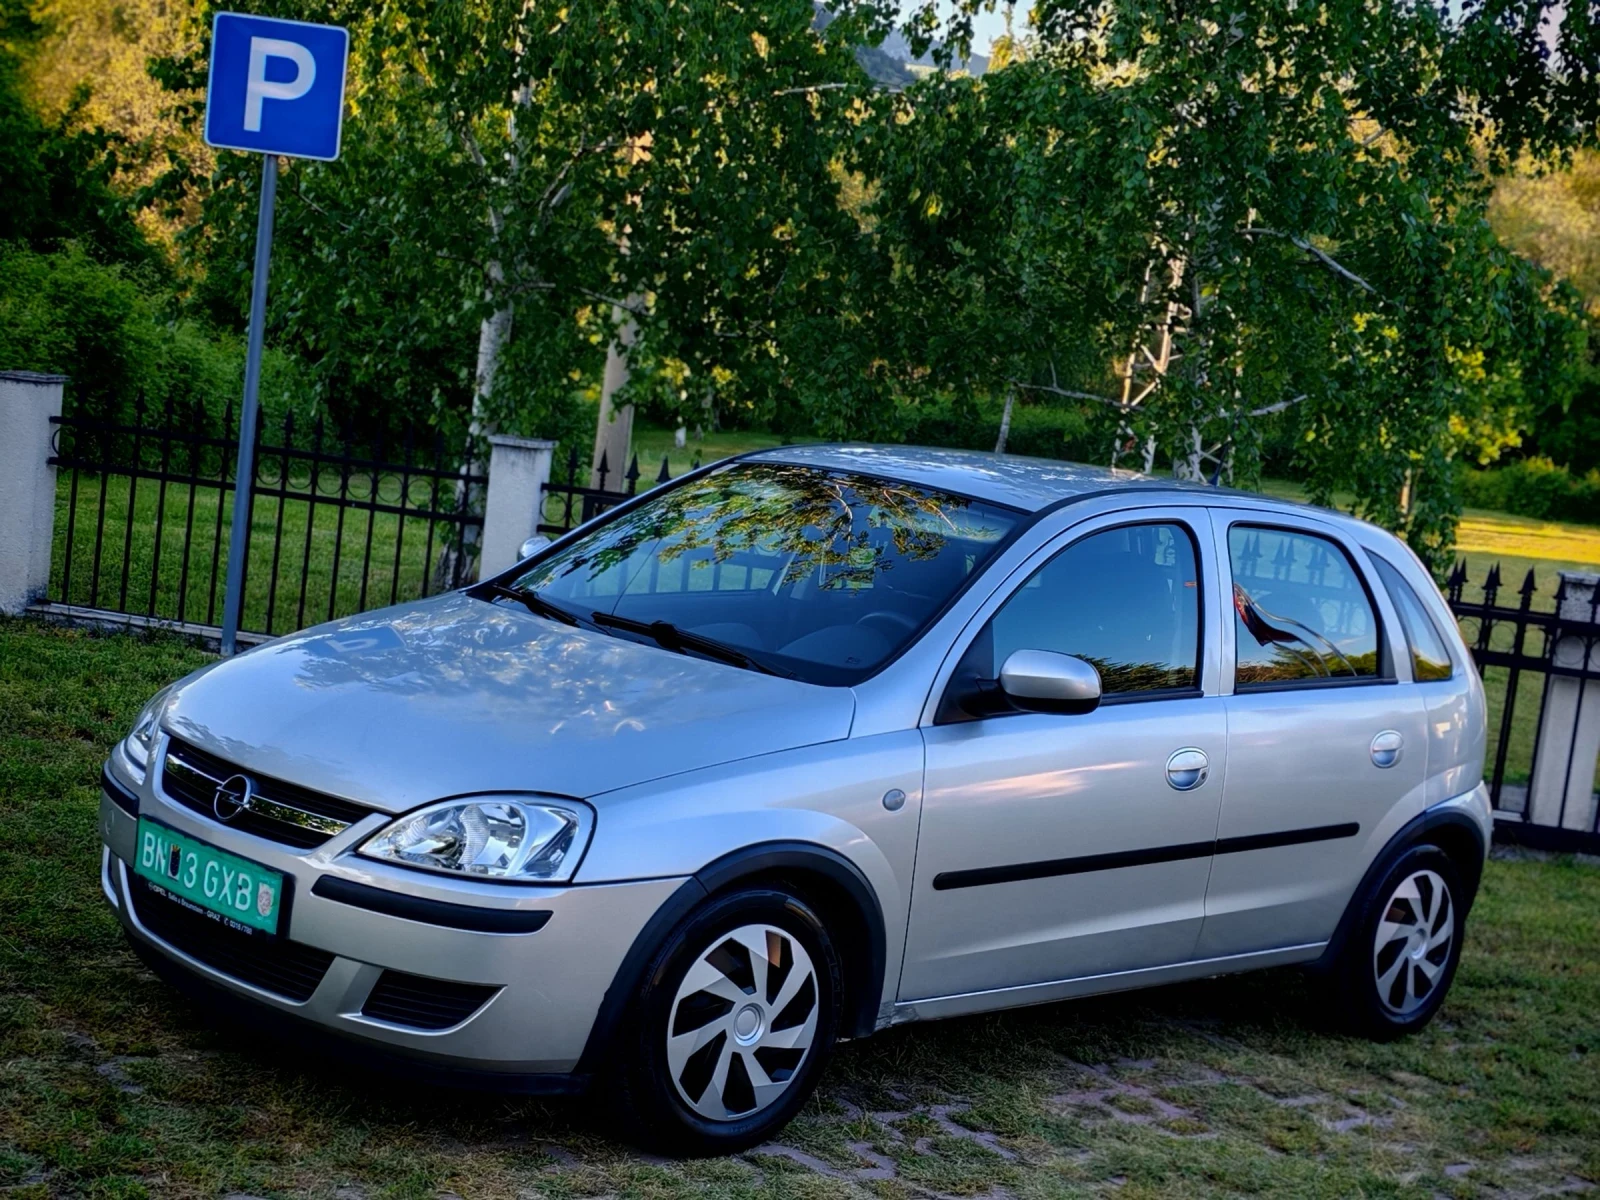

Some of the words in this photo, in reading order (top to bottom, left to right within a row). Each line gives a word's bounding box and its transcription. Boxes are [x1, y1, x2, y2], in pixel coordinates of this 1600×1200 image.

[243, 36, 317, 132] P
[142, 831, 168, 875] BN
[183, 852, 199, 889] 3
[203, 860, 252, 911] GXB
